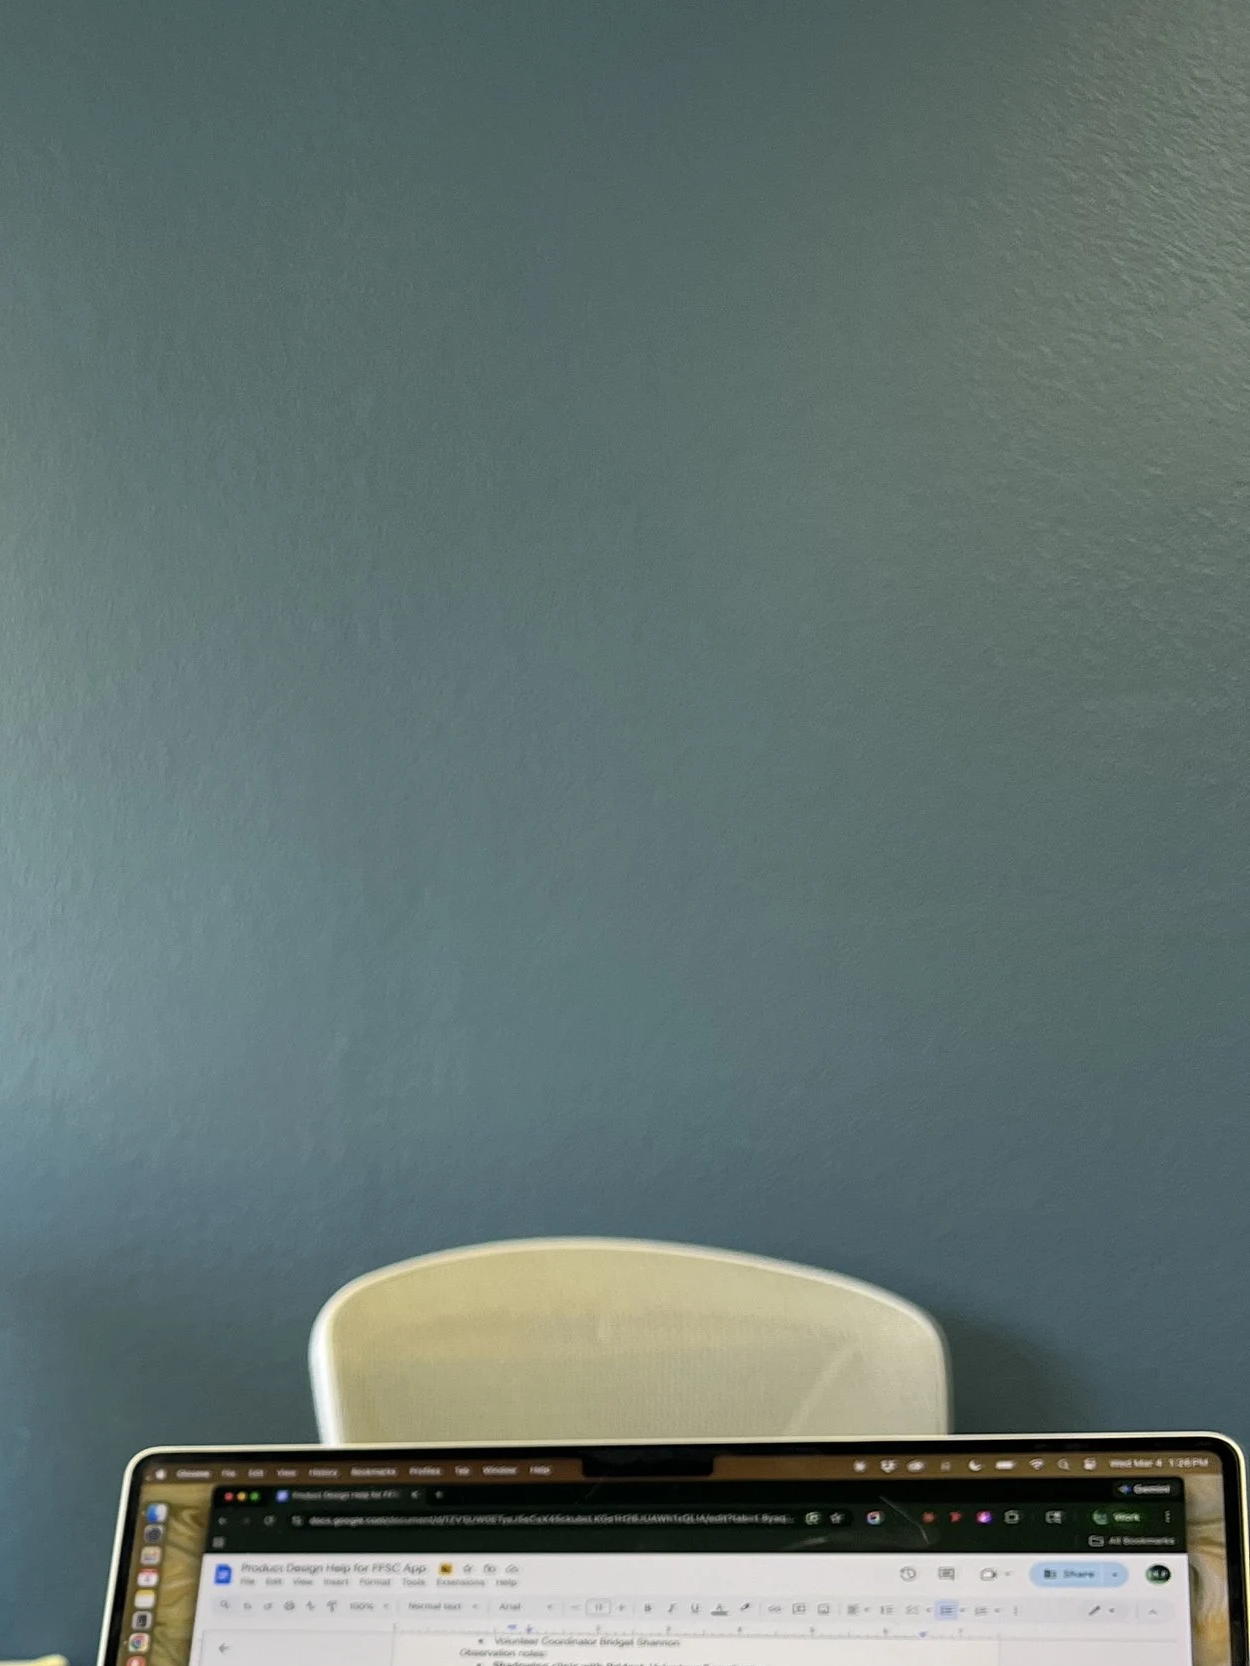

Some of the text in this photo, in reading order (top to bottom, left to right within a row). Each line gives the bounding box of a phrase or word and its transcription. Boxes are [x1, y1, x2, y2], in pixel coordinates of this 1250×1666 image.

[241, 1562, 426, 1575] Product Design Help for FFSC App
